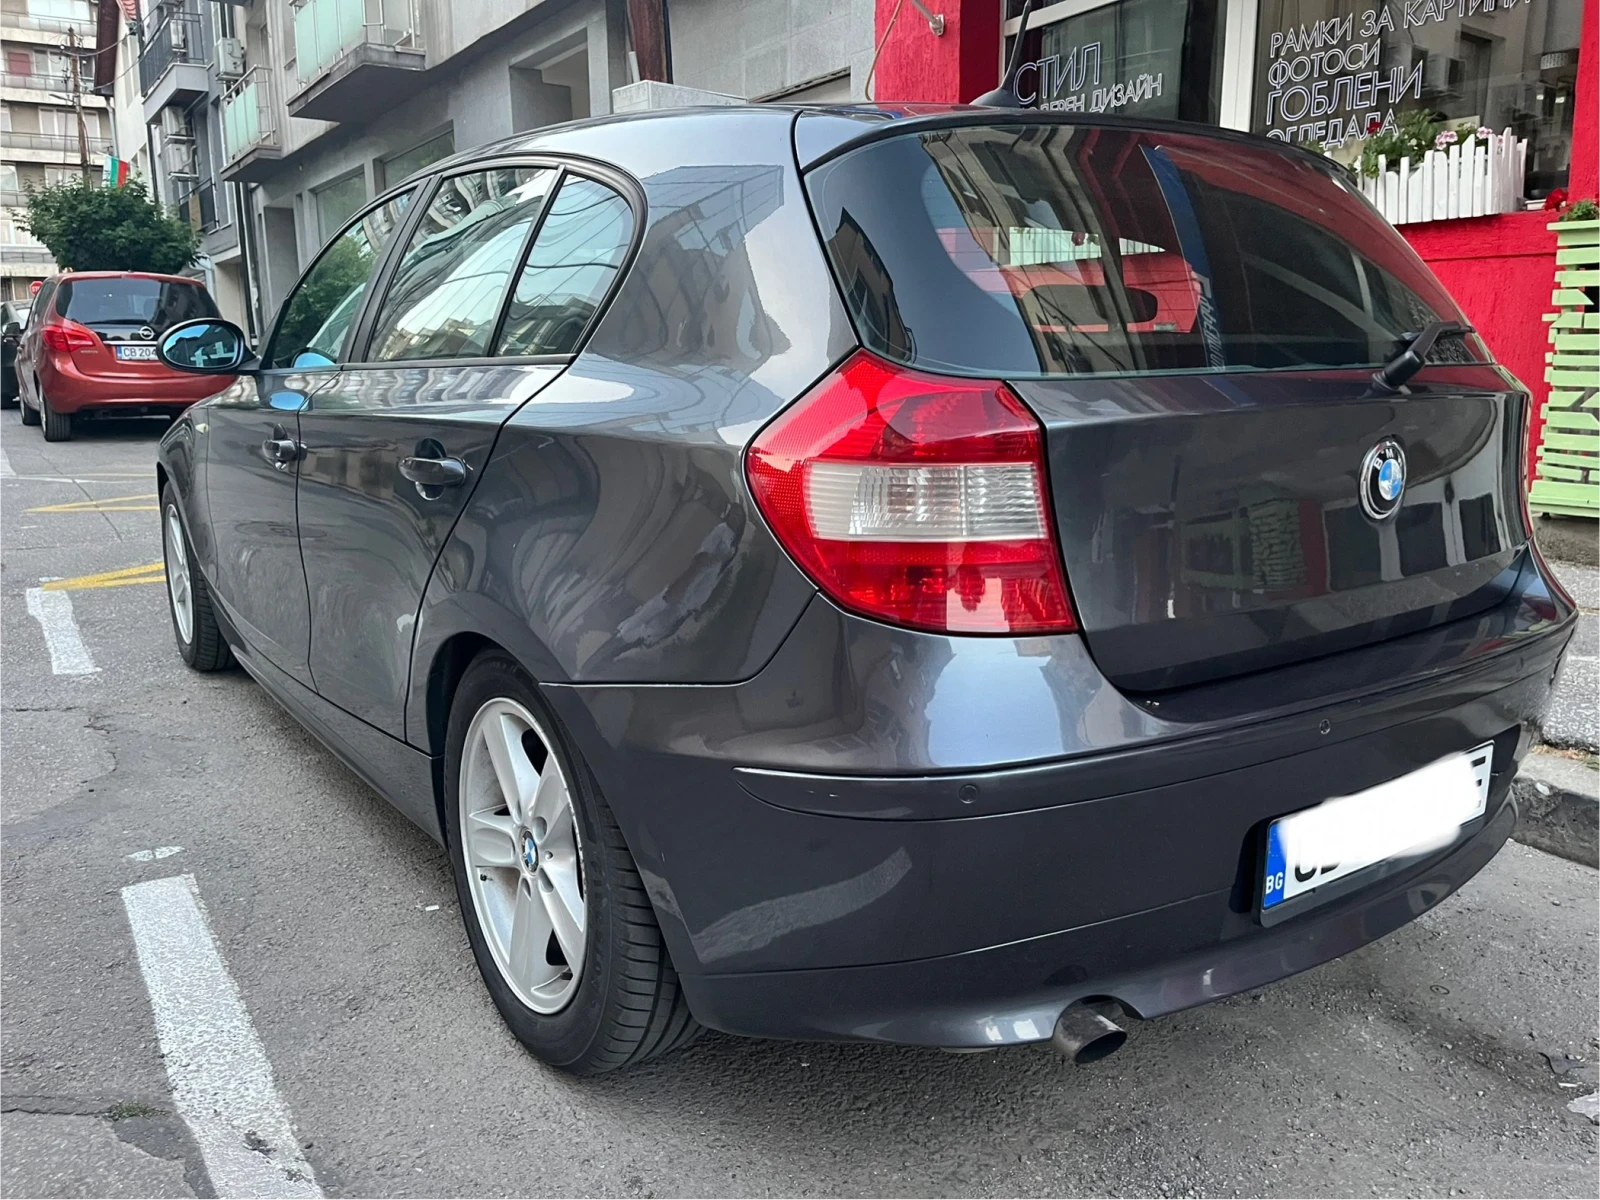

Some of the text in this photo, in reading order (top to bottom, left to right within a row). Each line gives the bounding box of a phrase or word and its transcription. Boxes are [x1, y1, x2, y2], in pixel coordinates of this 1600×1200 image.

[1270, 0, 1530, 58] РАМКИ ЗА КАРТИ
[1014, 42, 1100, 104] СТИЛ
[1268, 38, 1380, 89] ФОТОСИ
[1022, 73, 1162, 113] ЕРЕН ДИЗАЙН
[1266, 60, 1423, 125] ГОБЛЕНИ
[1265, 871, 1284, 895] BG
